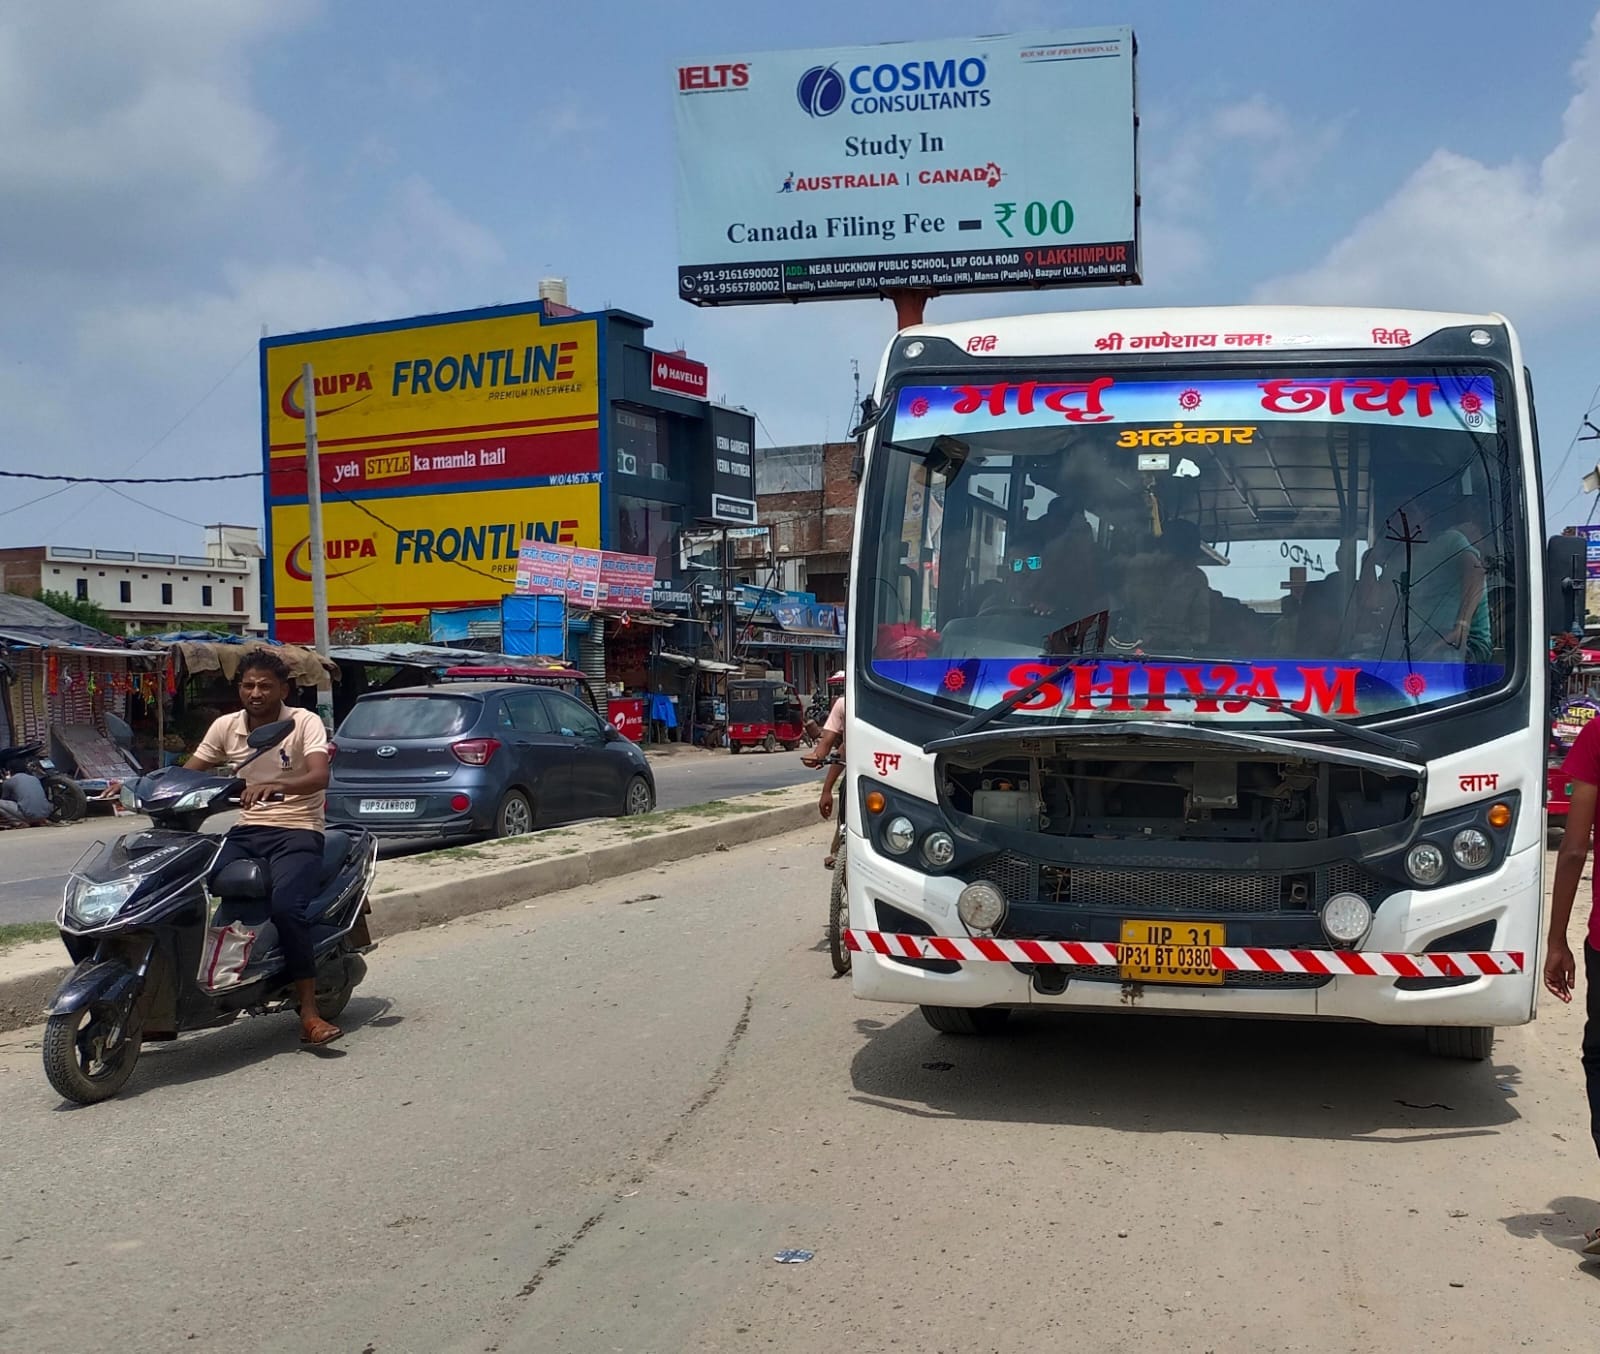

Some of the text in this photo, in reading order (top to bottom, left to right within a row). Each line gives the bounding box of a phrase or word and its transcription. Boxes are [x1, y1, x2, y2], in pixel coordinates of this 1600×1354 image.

[678, 63, 750, 90] IELTS
[849, 58, 986, 94] COSMO
[851, 90, 991, 114] CONSULTANTS
[845, 132, 944, 159] Study In
[796, 173, 899, 192] AUSTRALIA
[918, 164, 1001, 187] CANADA
[727, 220, 817, 245] Canada
[825, 215, 895, 241] Filing
[904, 213, 945, 233] Fee
[809, 263, 832, 275] NEAR
[834, 261, 876, 273] LUCKNOW
[878, 259, 909, 271] PUBLIC
[912, 257, 949, 269] SCHOOL,
[951, 257, 968, 268] LRP
[970, 255, 994, 267] GOLA
[995, 254, 1020, 265] ROAD
[1038, 245, 1127, 265] LAKHIMPUR
[696, 267, 779, 281] +91-9161690002
[817, 279, 855, 290] Lakhimpur
[933, 272, 952, 283] Ratia
[954, 271, 973, 283] (HR),
[974, 270, 999, 281] Mansa
[1001, 268, 1034, 280] (Punjab),
[1035, 267, 1061, 279] Bazpur
[1088, 264, 1108, 274] Delhi
[1110, 264, 1127, 273] NCR
[696, 281, 780, 294] +91-9565780002
[1095, 331, 1273, 350] श्री गणेशाय नमः
[392, 341, 578, 397] FRONTLINE
[668, 368, 703, 386] HAVELLS
[488, 383, 582, 400] PREMIUM INNERWEAR
[952, 377, 1440, 422] मातृ छाया
[1116, 422, 1256, 447] अलंकार
[333, 447, 506, 483] yeh STYLE ka mamla hai!
[308, 538, 377, 560] UPA
[396, 519, 579, 565] FRONTLINE
[491, 564, 517, 574] PREMI
[1003, 663, 1362, 716] SHIVAM
[874, 752, 902, 777] शुभ
[1459, 773, 1499, 792] लाभ
[1188, 929, 1210, 946] 31
[1116, 945, 1211, 967] UP31 BT 0380
